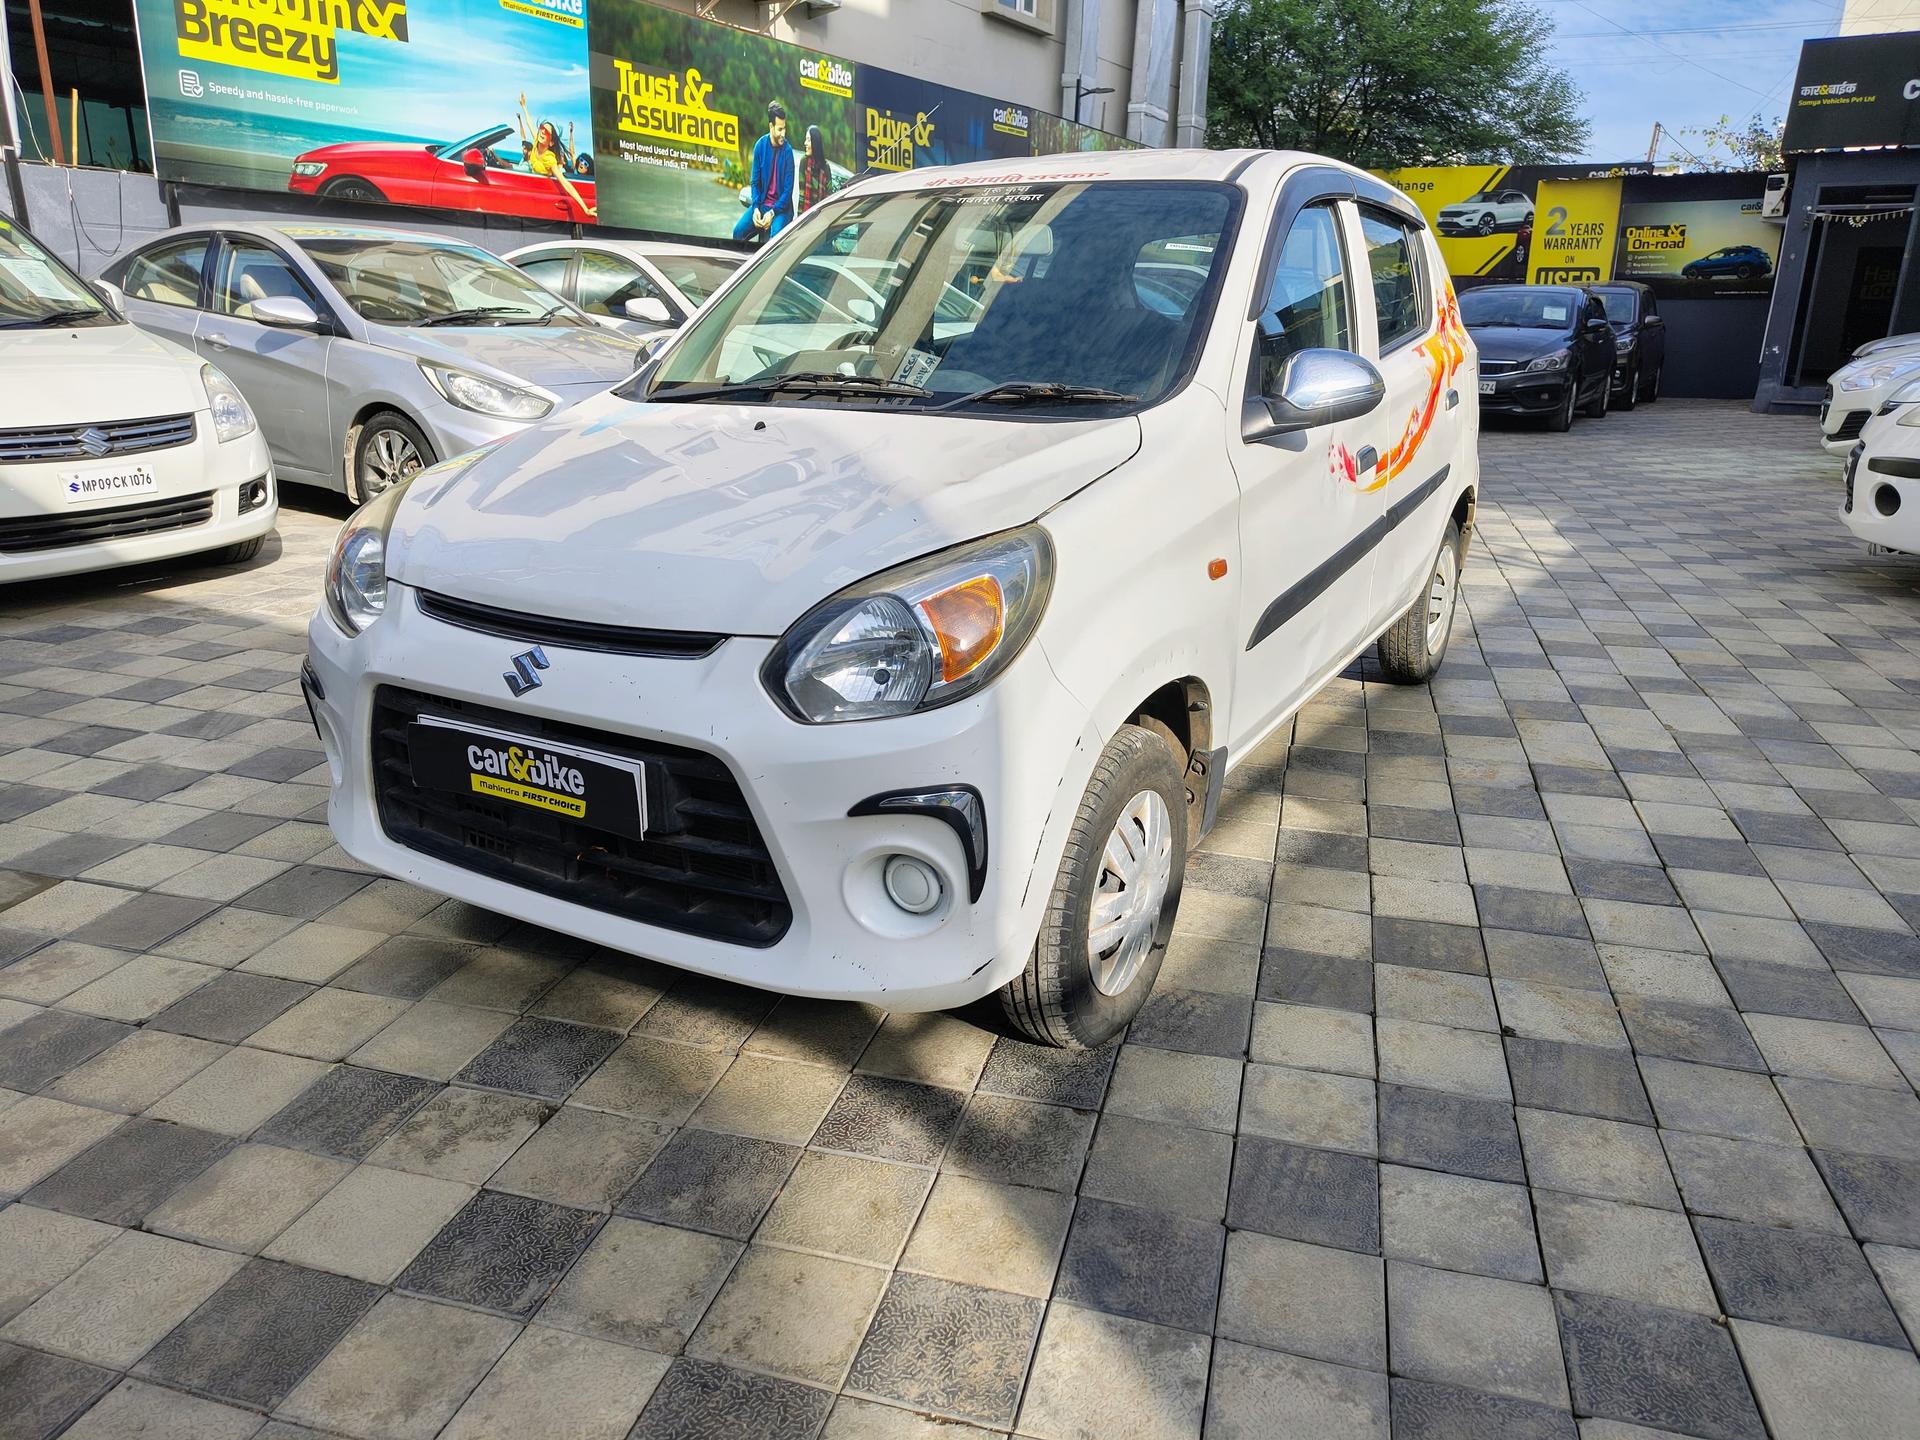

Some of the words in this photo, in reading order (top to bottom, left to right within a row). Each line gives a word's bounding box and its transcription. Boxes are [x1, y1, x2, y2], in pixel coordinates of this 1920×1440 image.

[535, 10, 553, 19] FIRST
[554, 15, 577, 25] CHOICE
[174, 0, 339, 80] Breezy
[614, 60, 679, 103] Trust
[684, 68, 713, 110] &
[800, 59, 852, 87] car&bike
[208, 81, 244, 98] Speedy
[247, 89, 264, 100] and
[265, 92, 314, 108] hassle-free
[315, 102, 359, 114] paperwork
[618, 95, 736, 145] Assurance
[866, 108, 911, 140] Drive
[914, 112, 935, 147] &
[620, 140, 636, 150] Most
[636, 143, 652, 154] loved
[654, 146, 669, 156] Used
[670, 149, 680, 157] Car
[680, 151, 697, 160] brand
[697, 154, 704, 162] of
[704, 155, 719, 164] India
[624, 152, 633, 163] By
[634, 154, 663, 166] Franchise
[664, 159, 680, 170] India,
[681, 162, 688, 170] ET
[867, 136, 912, 169] Smile
[1004, 194, 1045, 203] सरकार
[1546, 206, 1568, 236] 2
[1570, 223, 1604, 236] YEARS
[1626, 227, 1665, 238] Online
[1667, 223, 1686, 238] &
[1544, 237, 1603, 250] WARRANTY
[1632, 238, 1686, 249] On-road
[1565, 256, 1576, 264] ON
[467, 745, 585, 796] car&bike
[522, 791, 548, 803] FIRST
[549, 798, 581, 812] CHOICE
